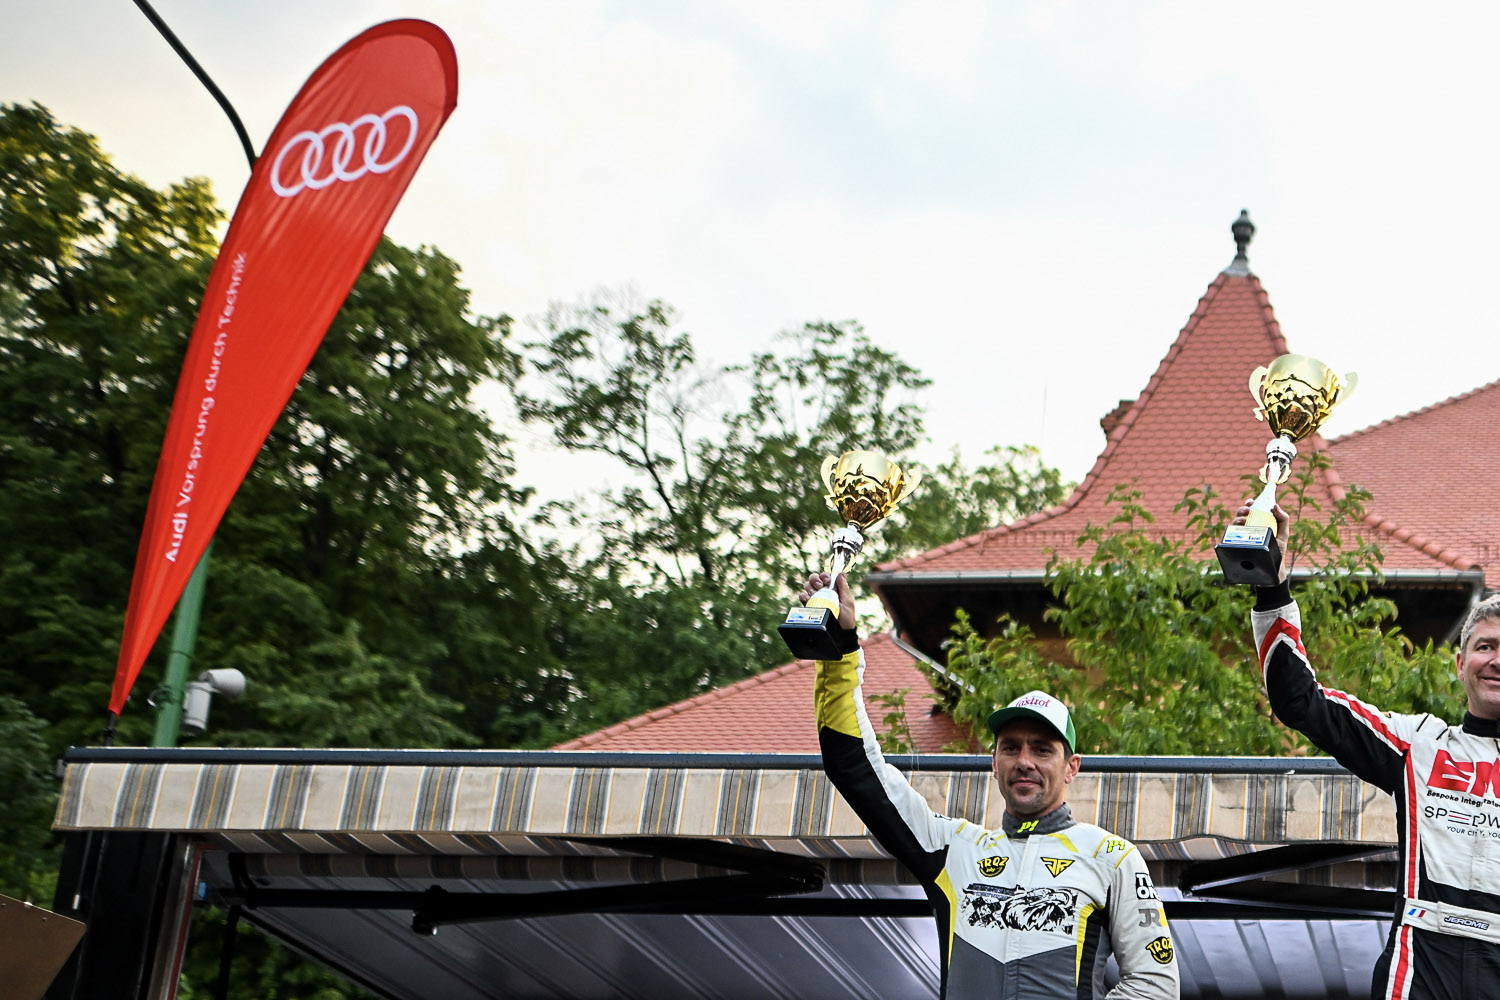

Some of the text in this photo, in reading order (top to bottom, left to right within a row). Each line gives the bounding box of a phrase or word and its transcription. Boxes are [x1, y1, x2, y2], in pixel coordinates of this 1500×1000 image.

[165, 252, 247, 562] Audi Vorsprung durch Technik
[1426, 789, 1459, 801] Bespoke
[1447, 825, 1466, 836] YOUR
[1444, 915, 1490, 931] JEROME
